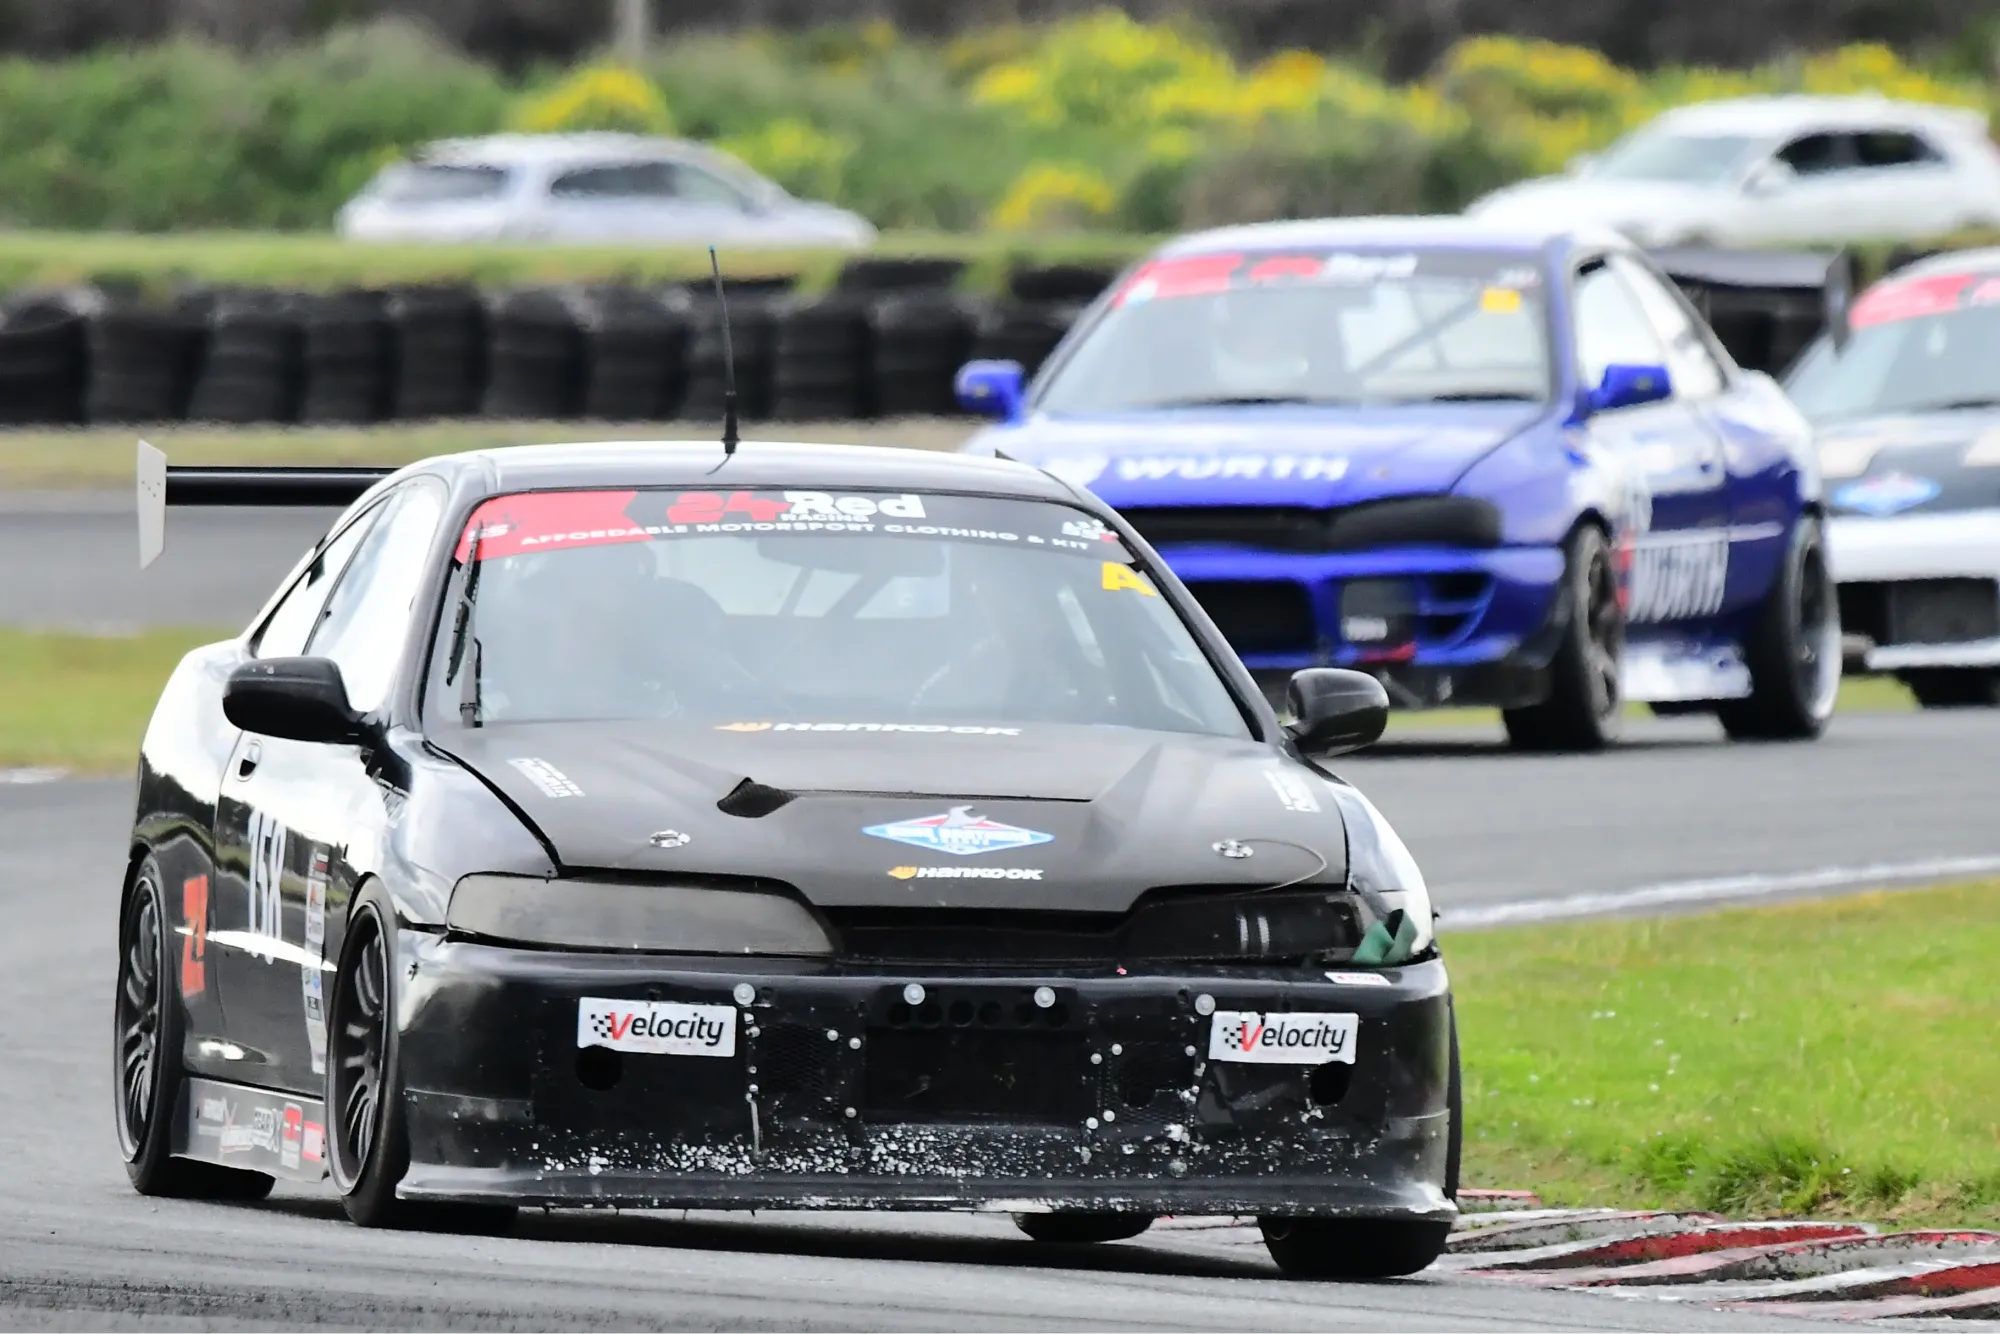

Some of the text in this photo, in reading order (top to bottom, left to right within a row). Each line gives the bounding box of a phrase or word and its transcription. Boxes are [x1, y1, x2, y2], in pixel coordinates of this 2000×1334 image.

[666, 490, 927, 524] 24 Red
[780, 513, 869, 523] RACING
[520, 524, 688, 546] AFFORDABLE
[696, 523, 876, 533] MOTORSPORT
[884, 524, 1019, 541] CLOTHING
[1027, 535, 1045, 544] &
[1052, 538, 1089, 550] KIT
[1101, 561, 1158, 597] A
[609, 1011, 724, 1047] Velocity
[1241, 1020, 1347, 1054] Velocity
